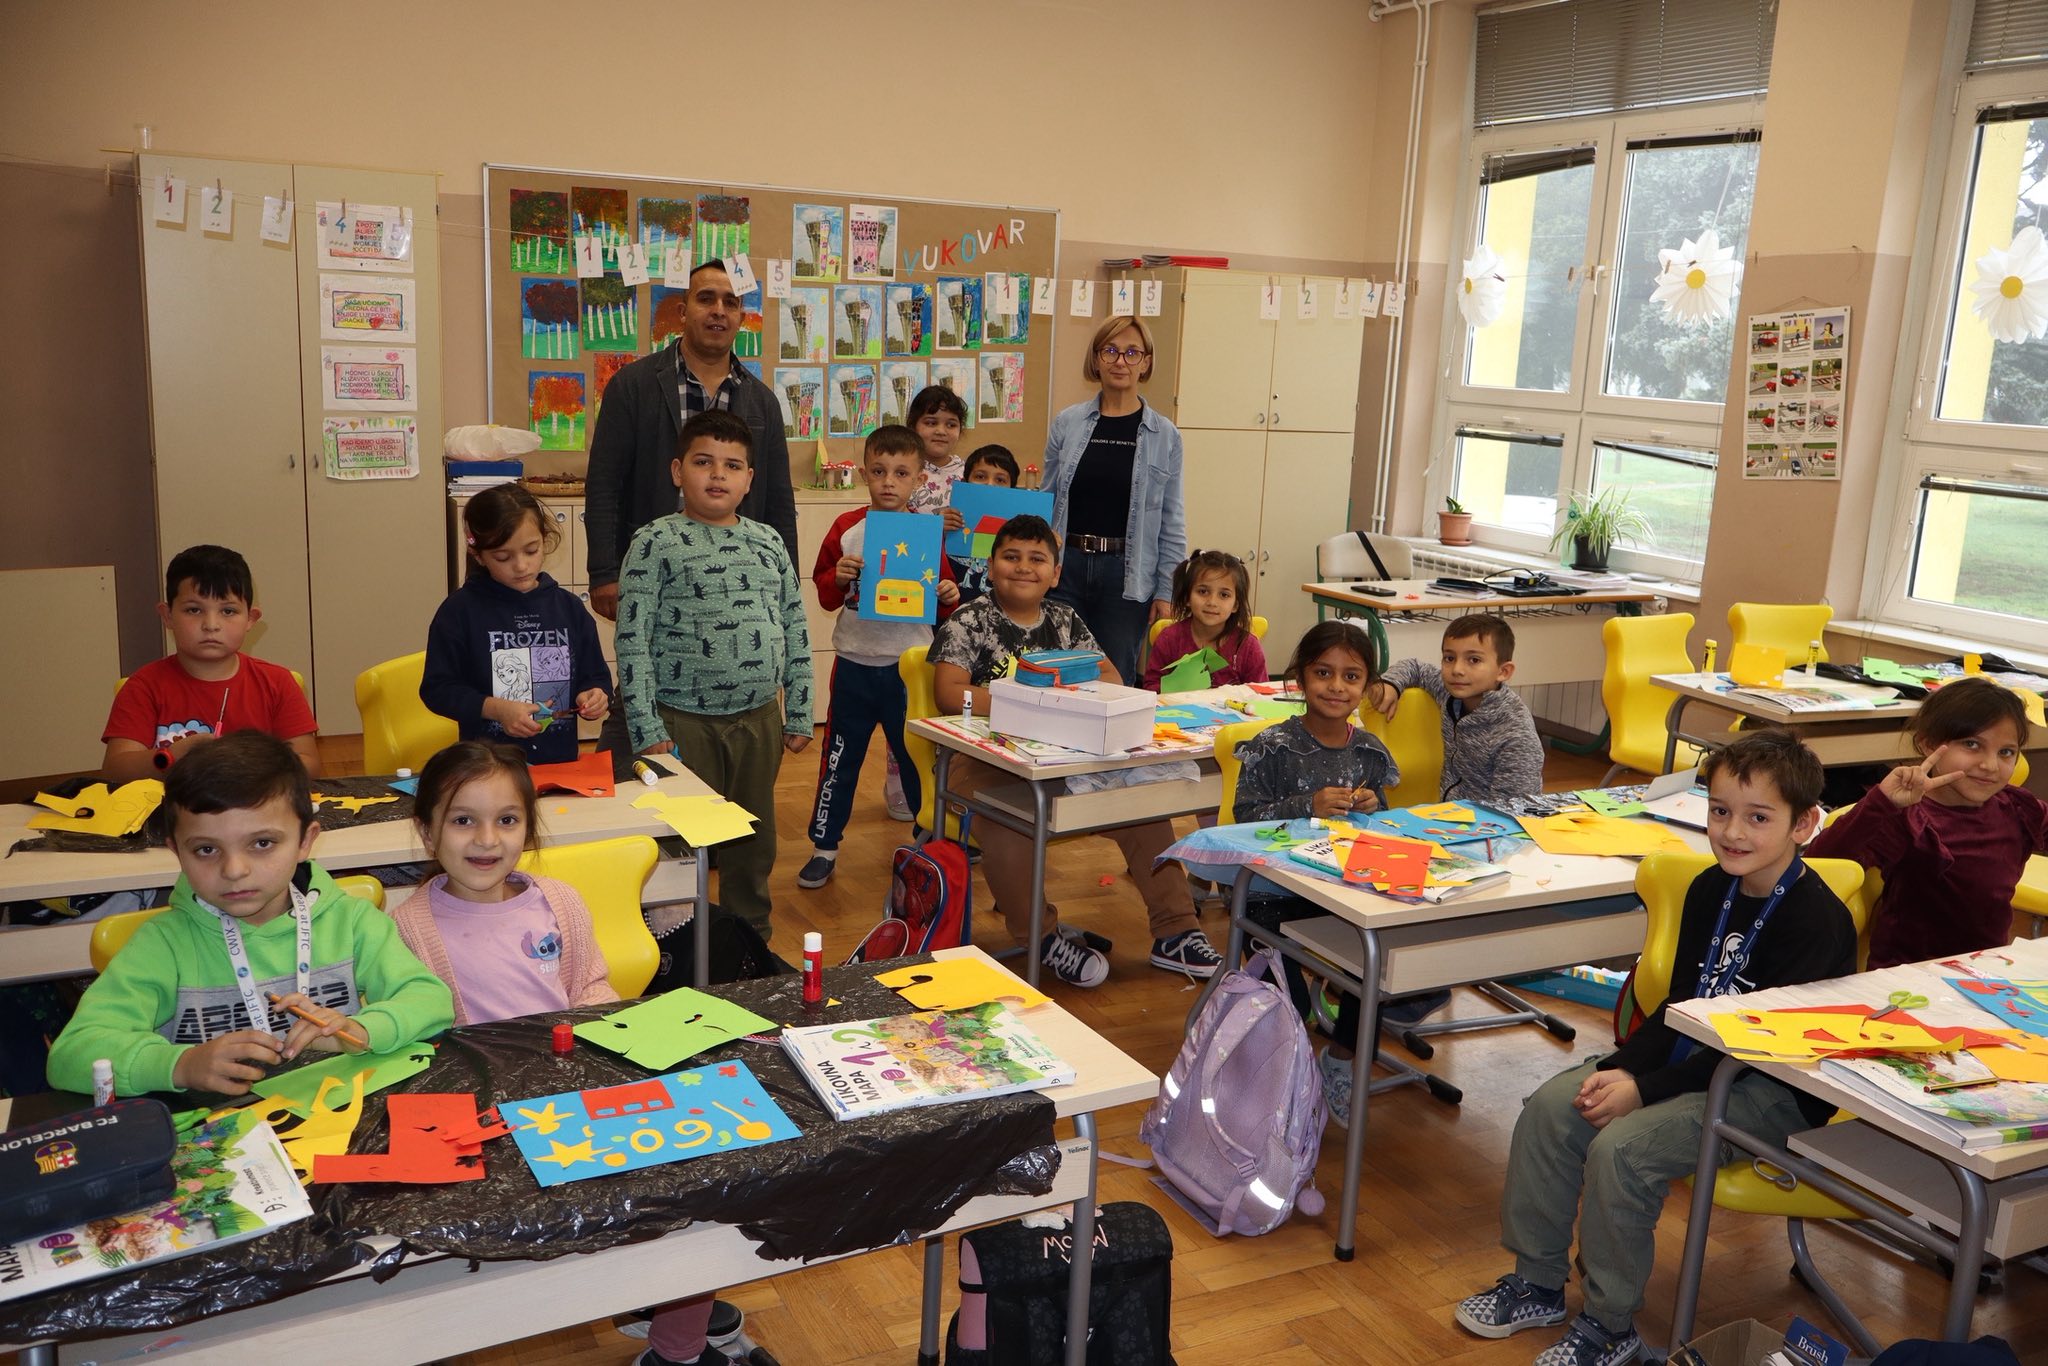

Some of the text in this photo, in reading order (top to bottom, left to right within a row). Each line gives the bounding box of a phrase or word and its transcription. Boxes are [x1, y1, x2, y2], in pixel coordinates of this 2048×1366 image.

[211, 195, 222, 214] 2
[335, 216, 346, 233] 4
[903, 218, 1025, 277] VUKOVAR
[584, 246, 784, 283] 1 2 3 4 5
[1003, 284, 1155, 302] 1 2 3 4 5
[1267, 288, 1398, 305] 1 2 3 4 5
[488, 627, 570, 652] FROZEN
[225, 927, 240, 956] CWIX
[300, 926, 310, 950] JFTC
[243, 988, 260, 1014] JFTC
[817, 1060, 860, 1105] LIKOVNA
[849, 1070, 882, 1101] MAPA
[96, 1115, 119, 1127] FC
[1797, 1336, 1829, 1364] Brush
